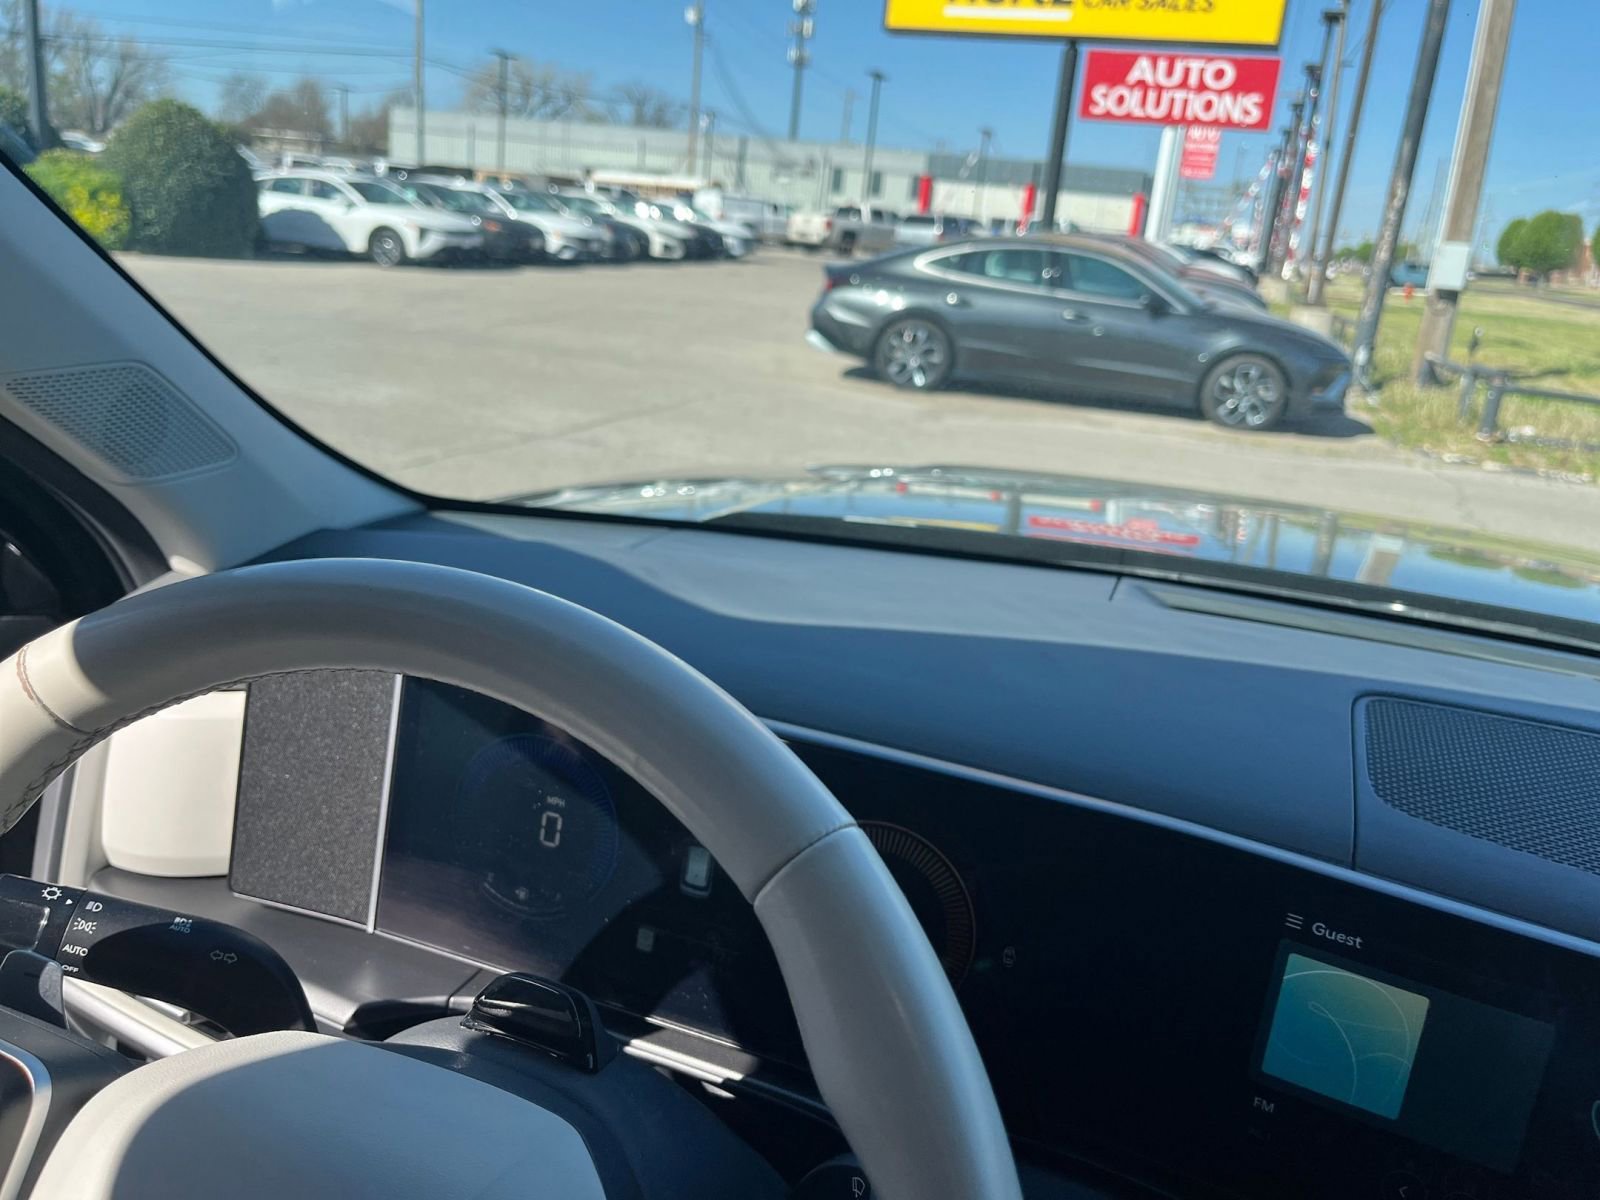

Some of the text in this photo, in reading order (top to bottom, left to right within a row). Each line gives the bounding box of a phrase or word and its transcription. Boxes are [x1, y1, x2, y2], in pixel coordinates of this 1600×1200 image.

[1125, 56, 1236, 91] AUTO
[1089, 84, 1264, 124] SOLUTIONS
[540, 811, 563, 848] 0
[168, 923, 191, 933] AUTO
[1312, 922, 1362, 949] Guest
[62, 943, 89, 957] AUTO
[61, 964, 79, 972] OFF
[1253, 1096, 1275, 1112] FM
